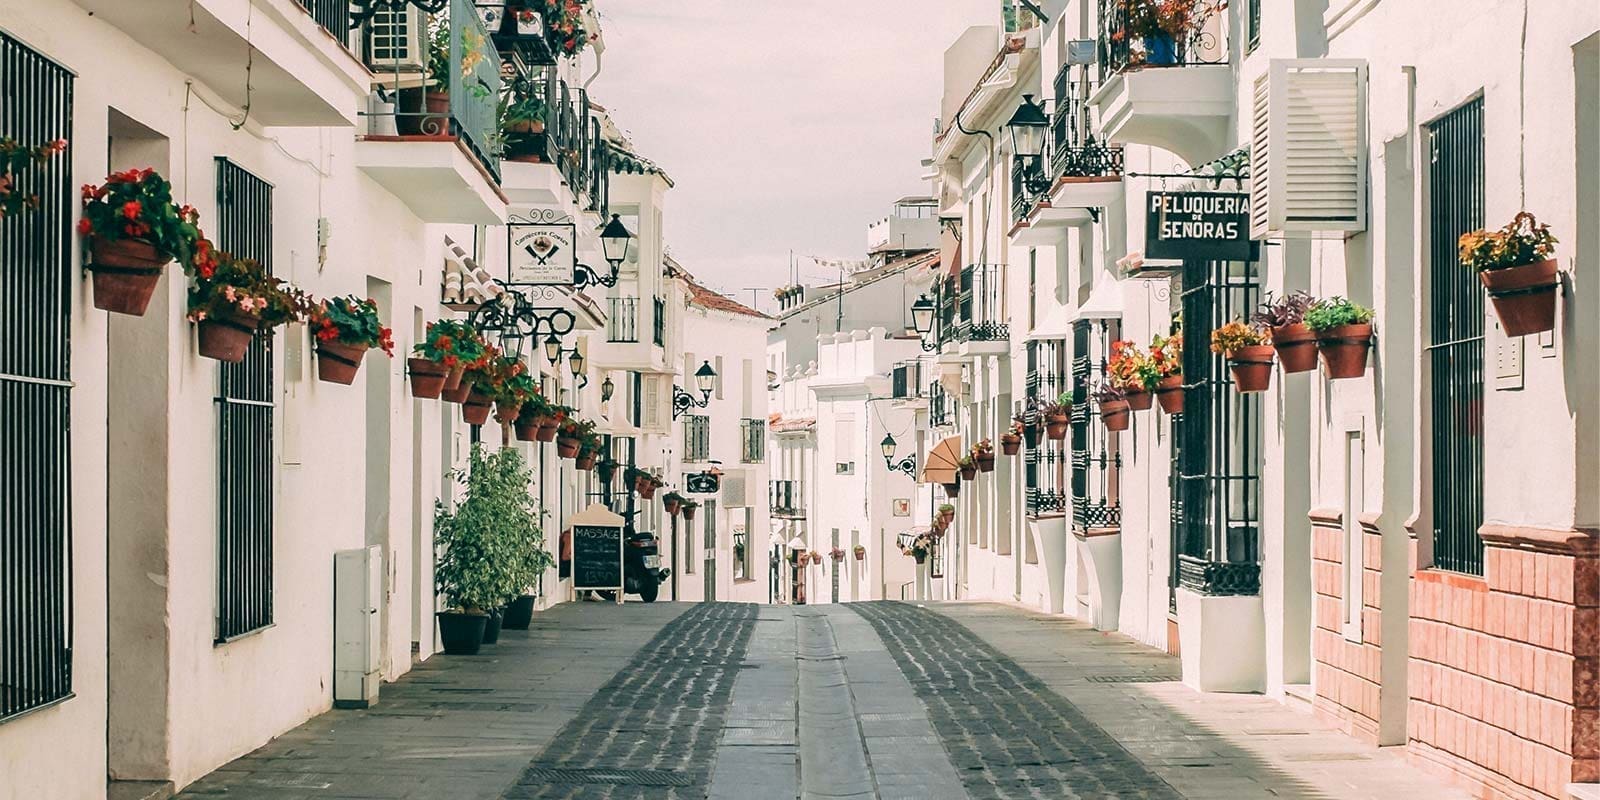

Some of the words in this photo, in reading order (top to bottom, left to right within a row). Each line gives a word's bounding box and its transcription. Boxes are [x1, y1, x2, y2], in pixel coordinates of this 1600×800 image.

[1151, 195, 1250, 214] PELUQUERIA
[1191, 213, 1203, 221] DE
[575, 527, 620, 540] MASSAGE
